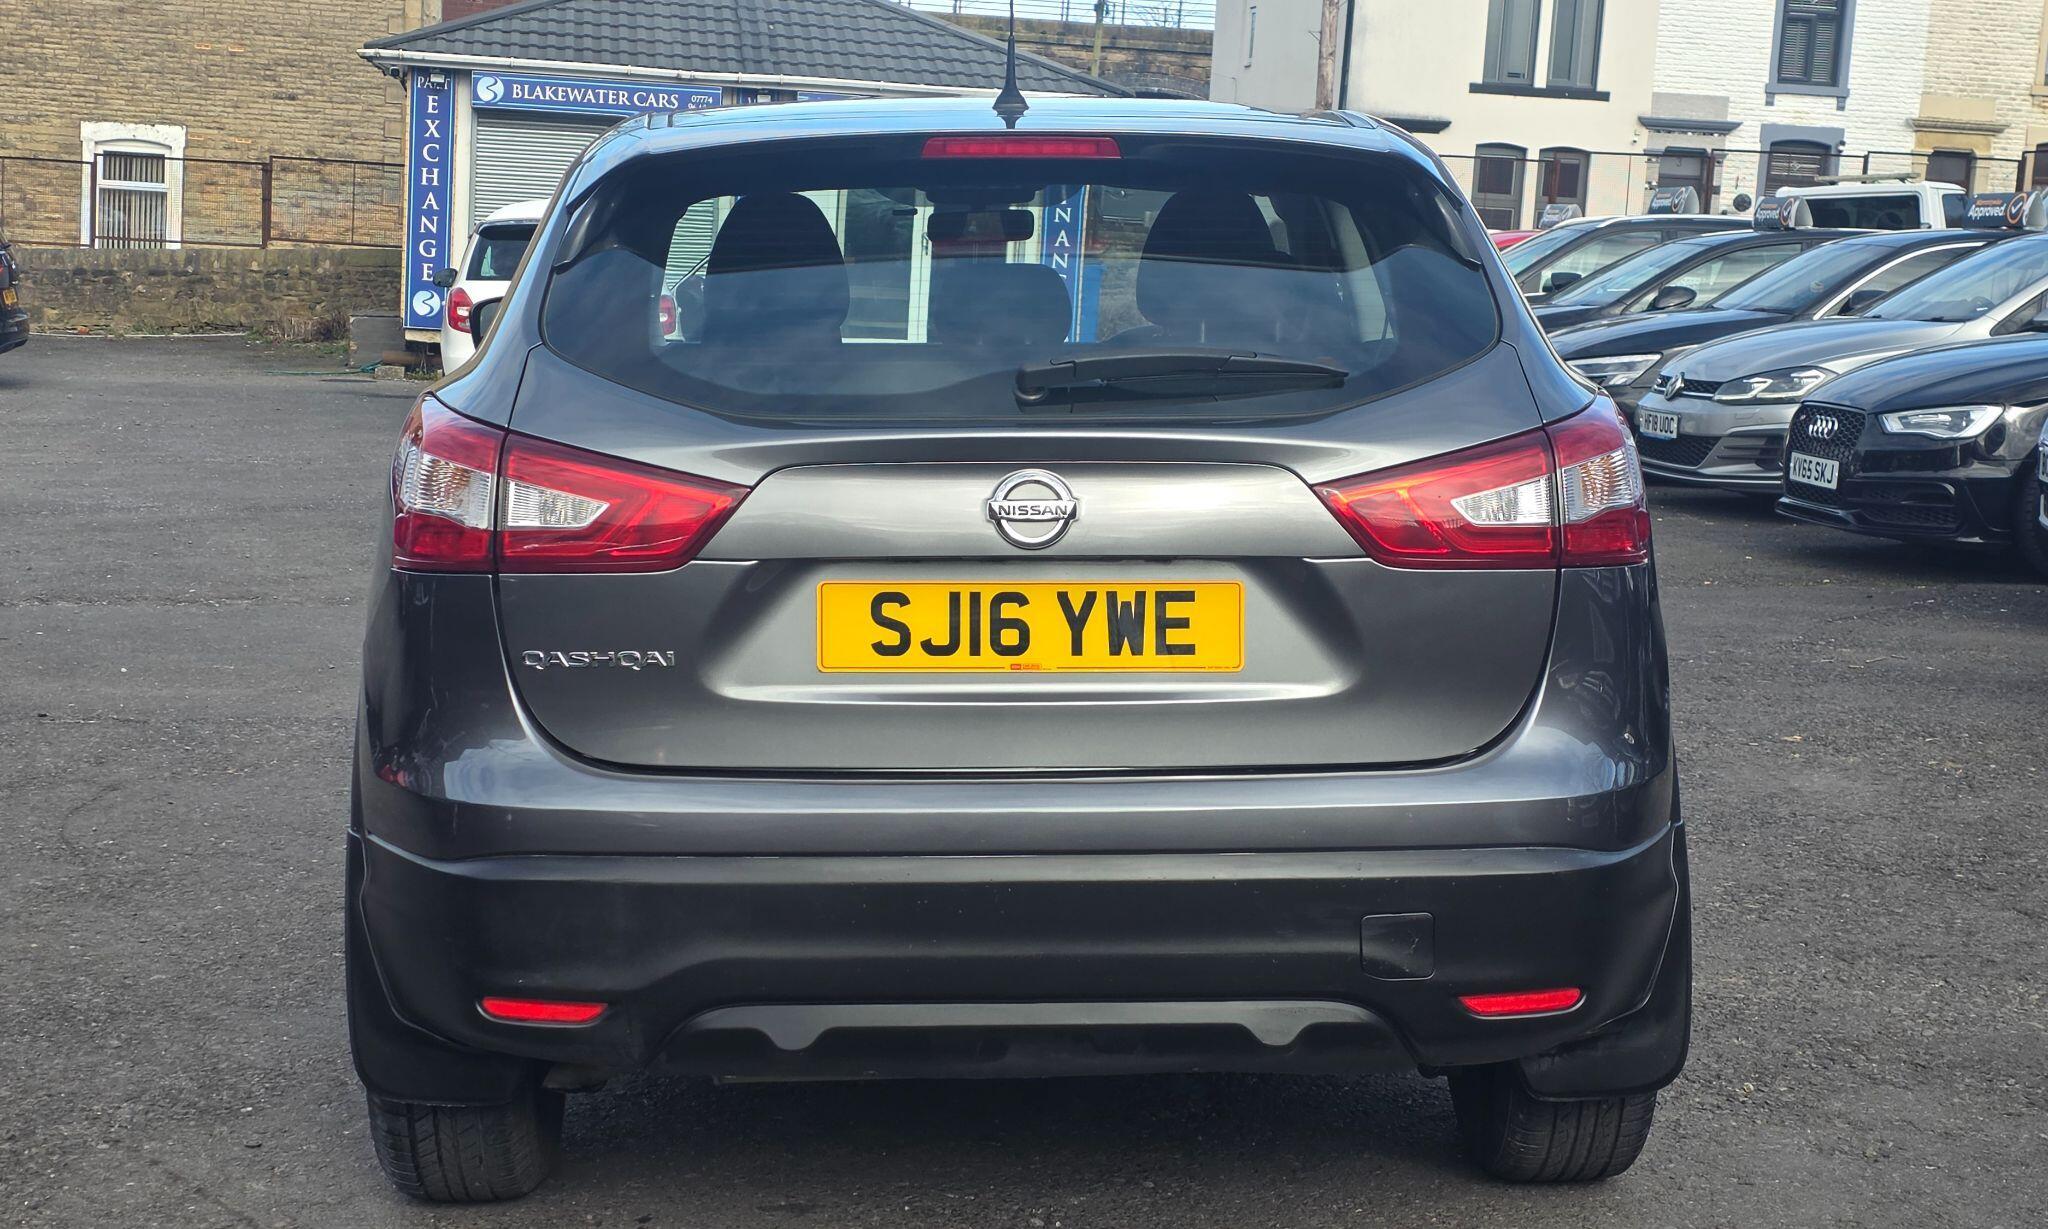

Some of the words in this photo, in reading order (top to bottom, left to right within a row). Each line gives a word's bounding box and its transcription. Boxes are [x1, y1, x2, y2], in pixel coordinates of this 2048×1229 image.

[512, 84, 630, 105] BLAKEWATER
[633, 92, 679, 109] CARS
[418, 95, 441, 281] EXCHANGE
[1814, 461, 1835, 484] SKJ
[998, 505, 1067, 516] NISSAN
[870, 591, 1030, 657] SJ16
[1056, 590, 1196, 656] YWE
[522, 650, 676, 671] QASHQAI
